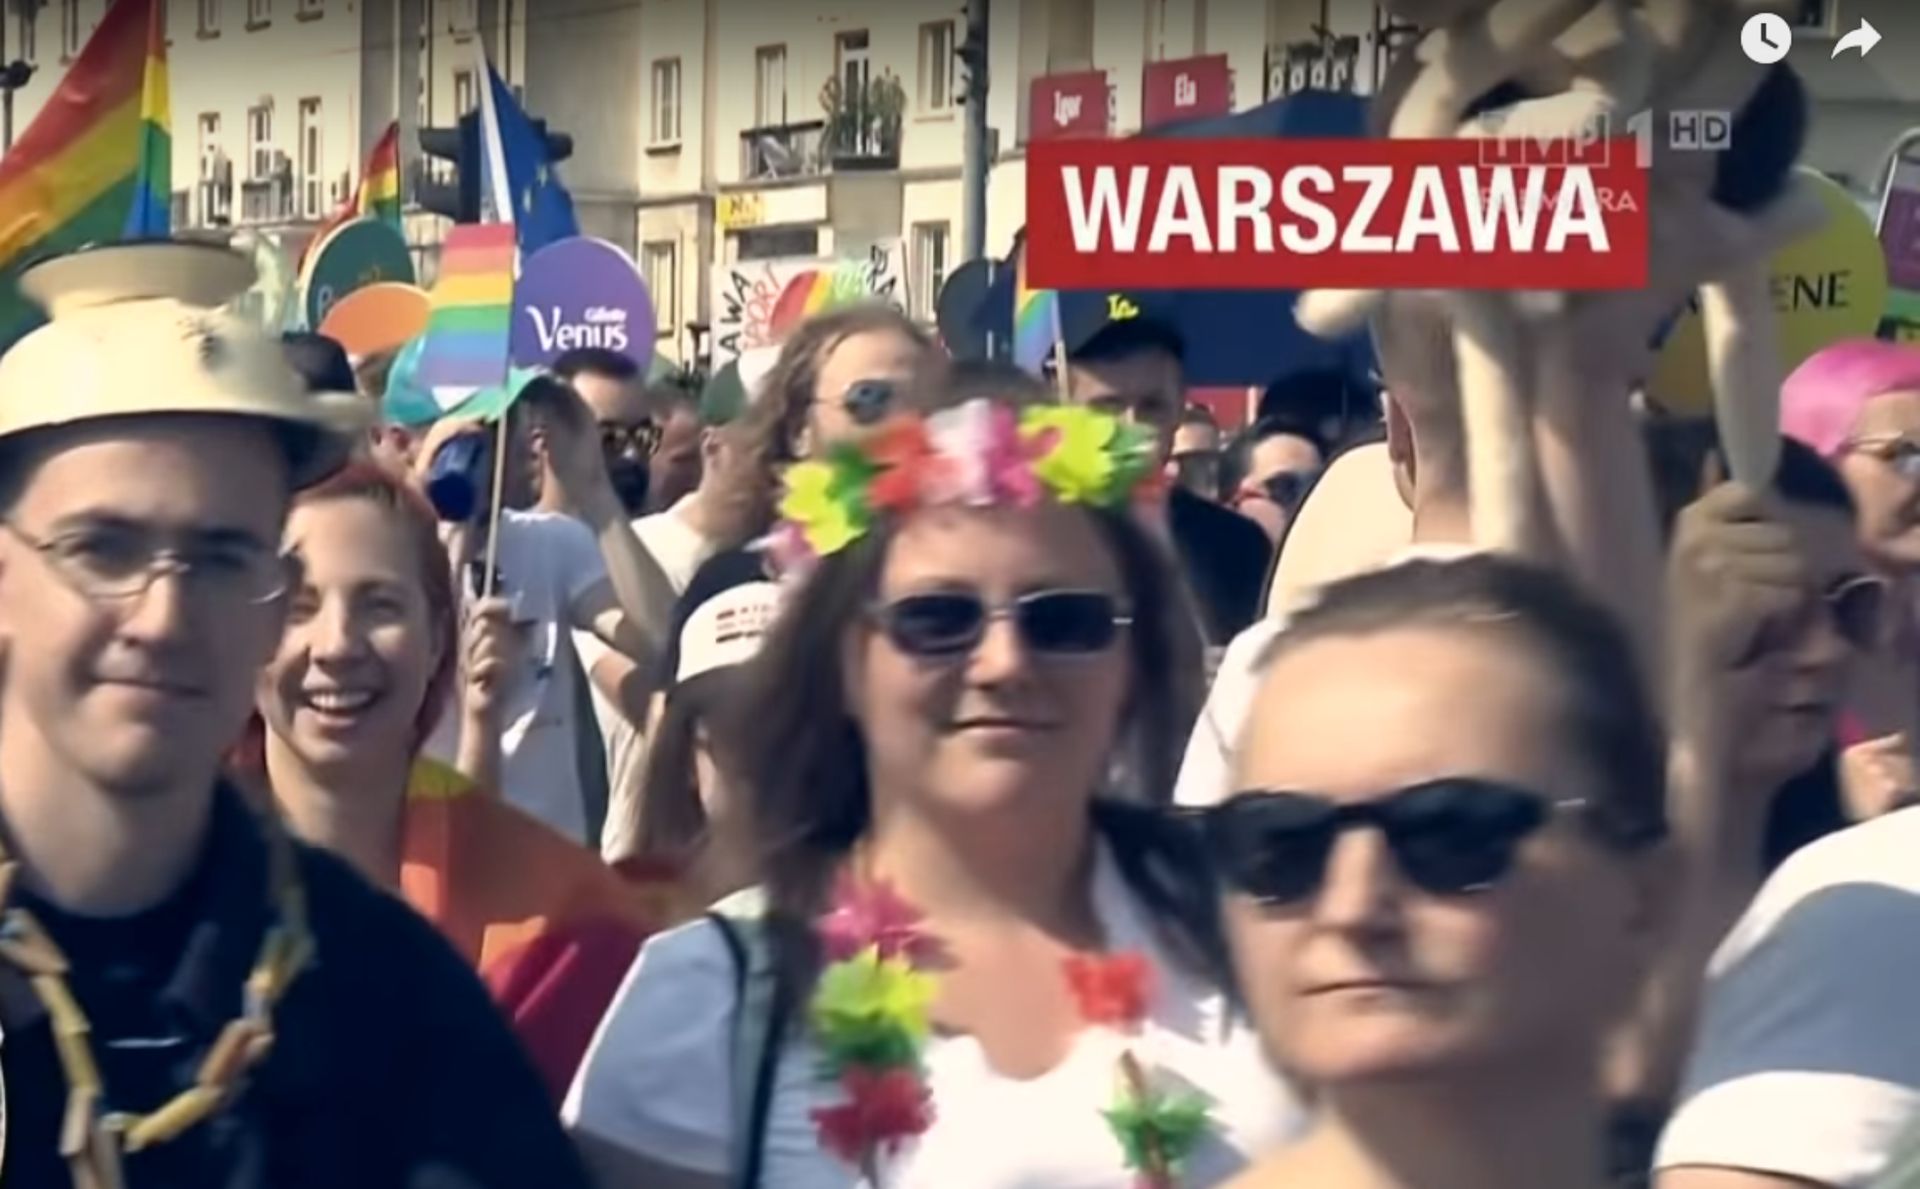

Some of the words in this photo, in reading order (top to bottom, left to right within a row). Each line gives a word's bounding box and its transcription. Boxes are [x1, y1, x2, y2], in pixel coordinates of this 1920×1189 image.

[1174, 72, 1197, 107] Ela
[1053, 90, 1082, 127] Igor
[525, 304, 628, 352] Venus
